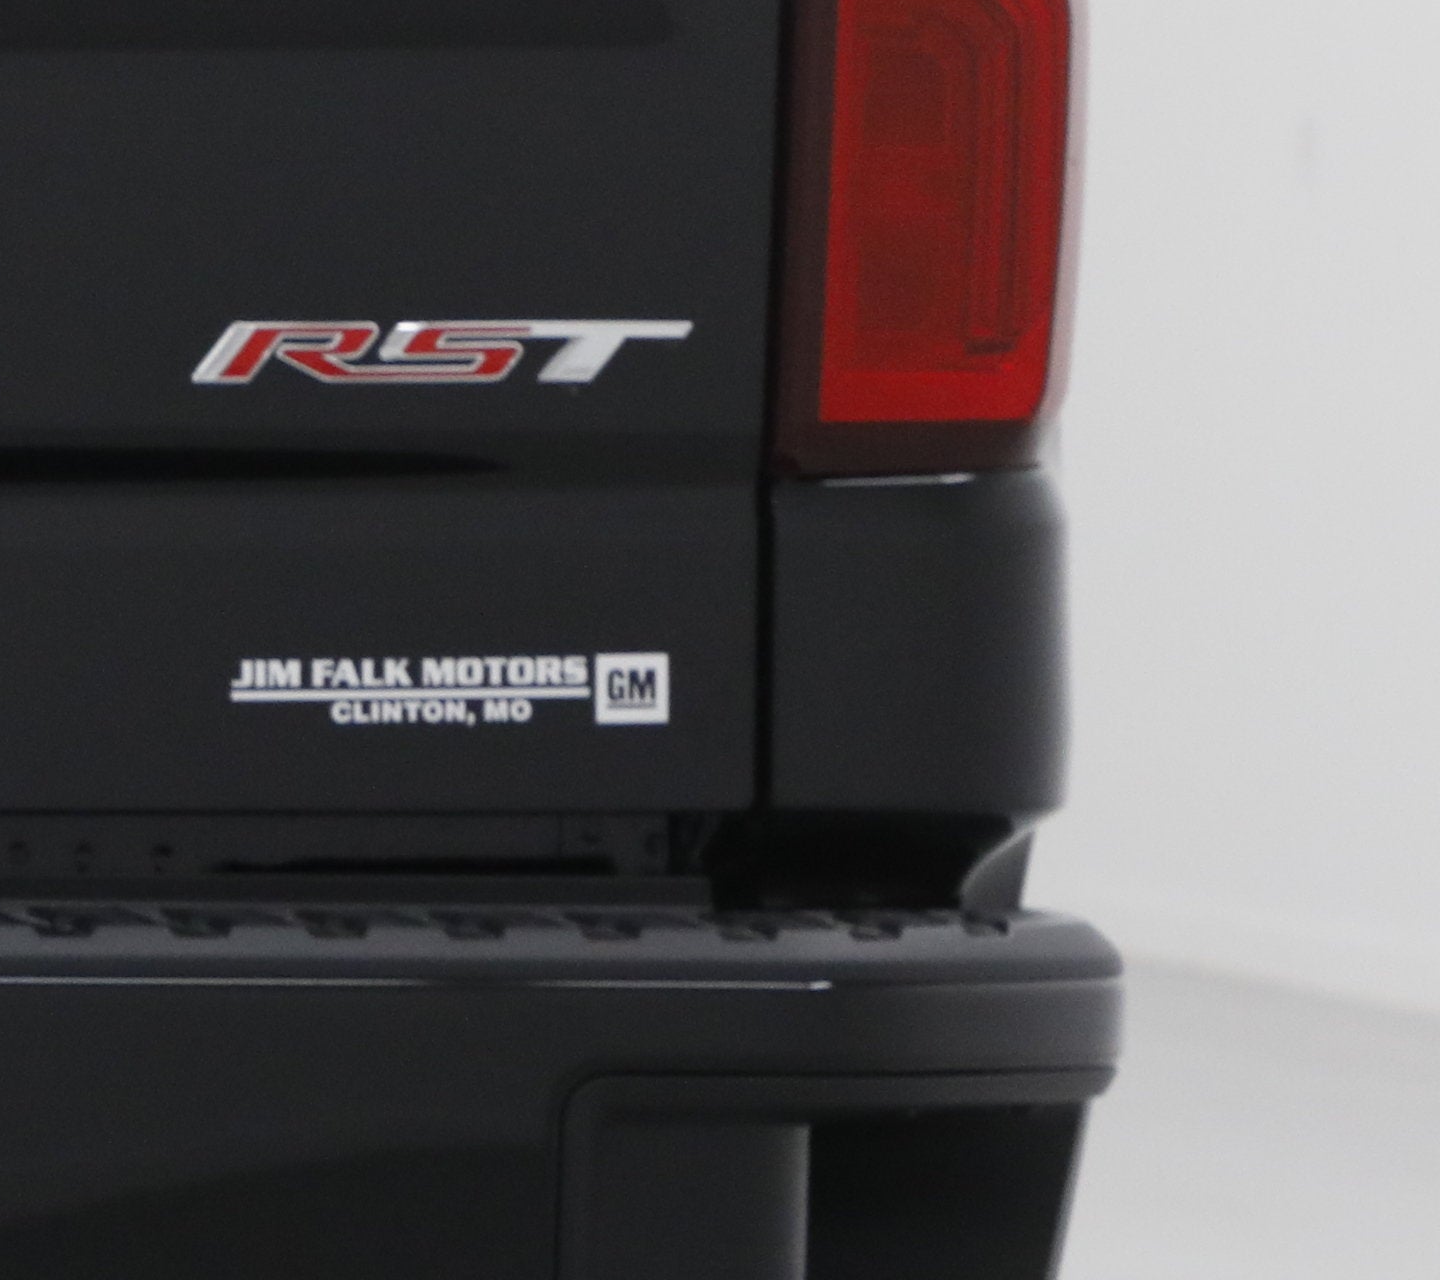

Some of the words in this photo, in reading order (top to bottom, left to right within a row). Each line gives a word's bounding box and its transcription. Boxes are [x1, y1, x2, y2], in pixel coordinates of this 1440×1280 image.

[191, 319, 694, 384] RST
[231, 657, 303, 688] JIM
[311, 656, 413, 688] FALK
[421, 654, 589, 686] MOTORS
[606, 667, 658, 703] GM
[329, 699, 477, 727] CLINTON,
[483, 698, 533, 723] MO
